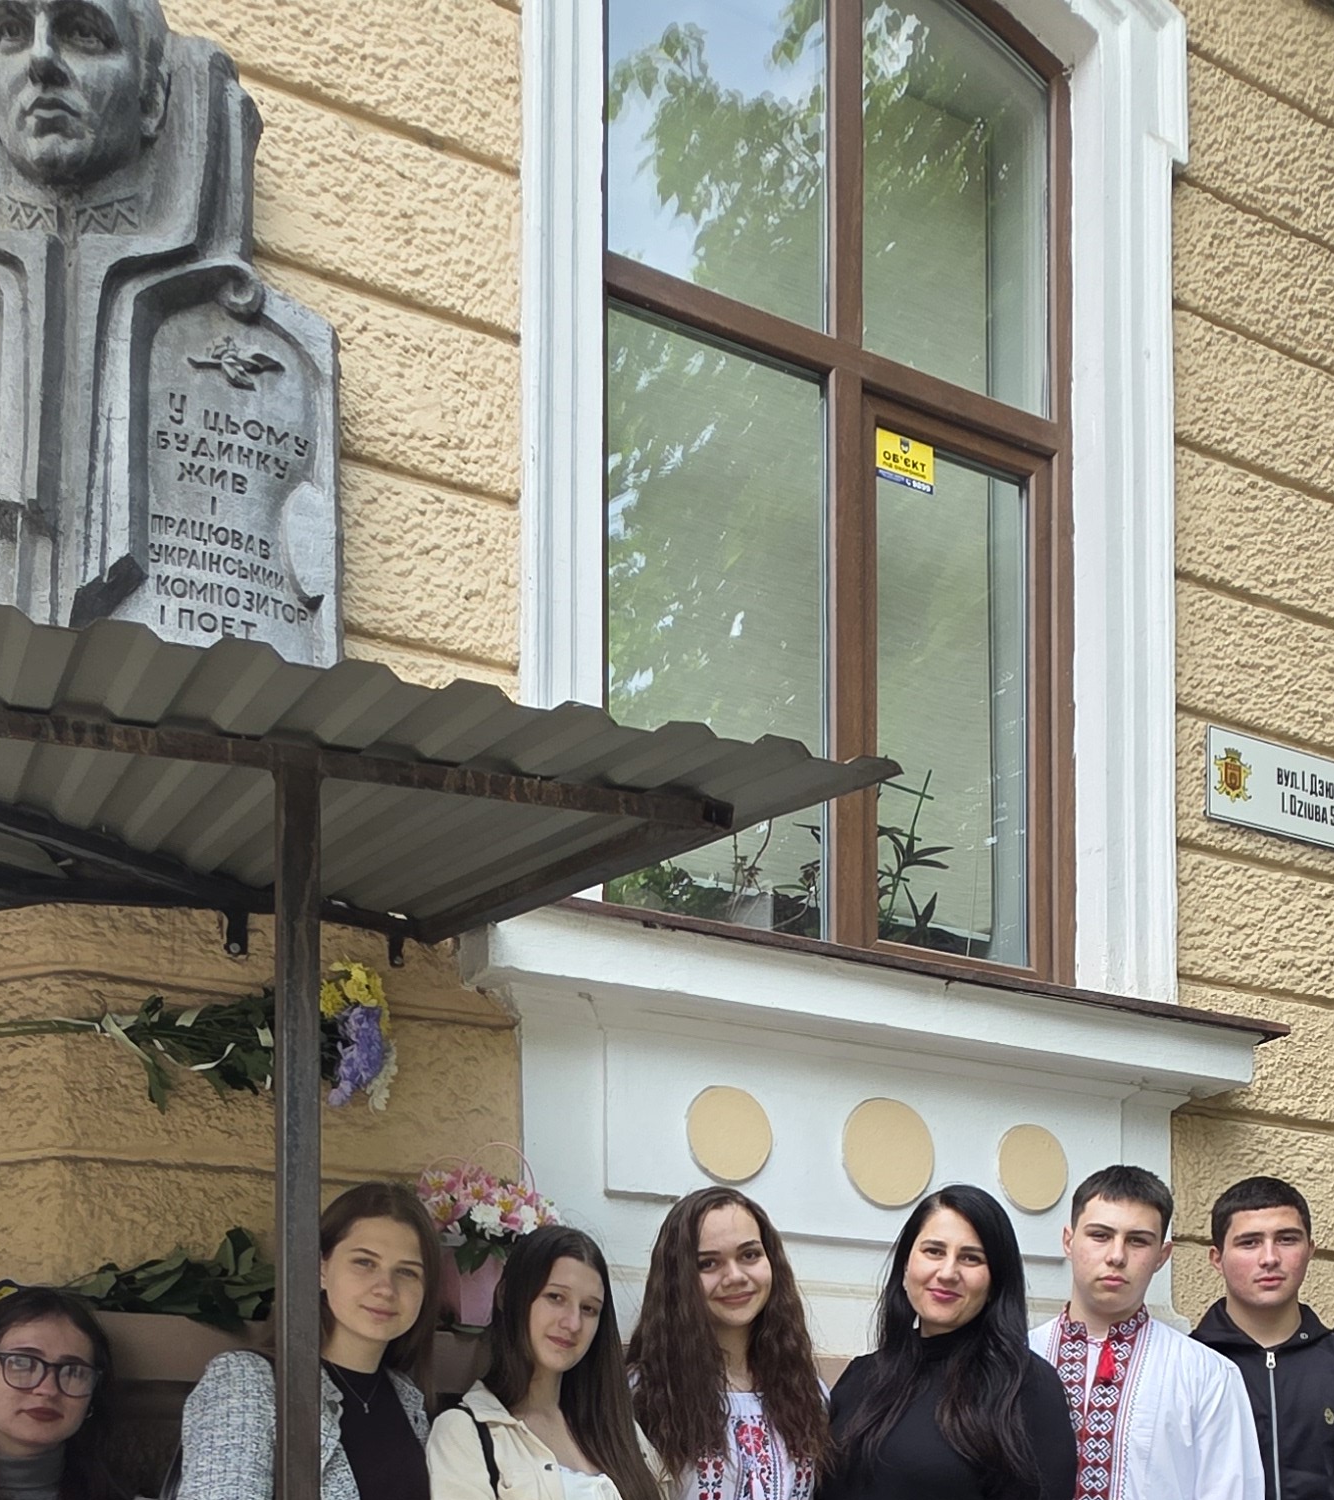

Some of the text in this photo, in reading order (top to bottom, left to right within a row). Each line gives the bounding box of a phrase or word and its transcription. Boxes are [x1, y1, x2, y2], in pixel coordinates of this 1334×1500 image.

[169, 392, 310, 457] У ЦЬОМУ
[157, 430, 290, 479] БУДИНКУ
[177, 461, 249, 495] ЖИВ
[210, 496, 218, 516] І
[151, 513, 271, 560] ПРАЦЮВАВ
[156, 573, 309, 626] КОМПОЗИТОР
[160, 604, 257, 639] І ПОЕТ
